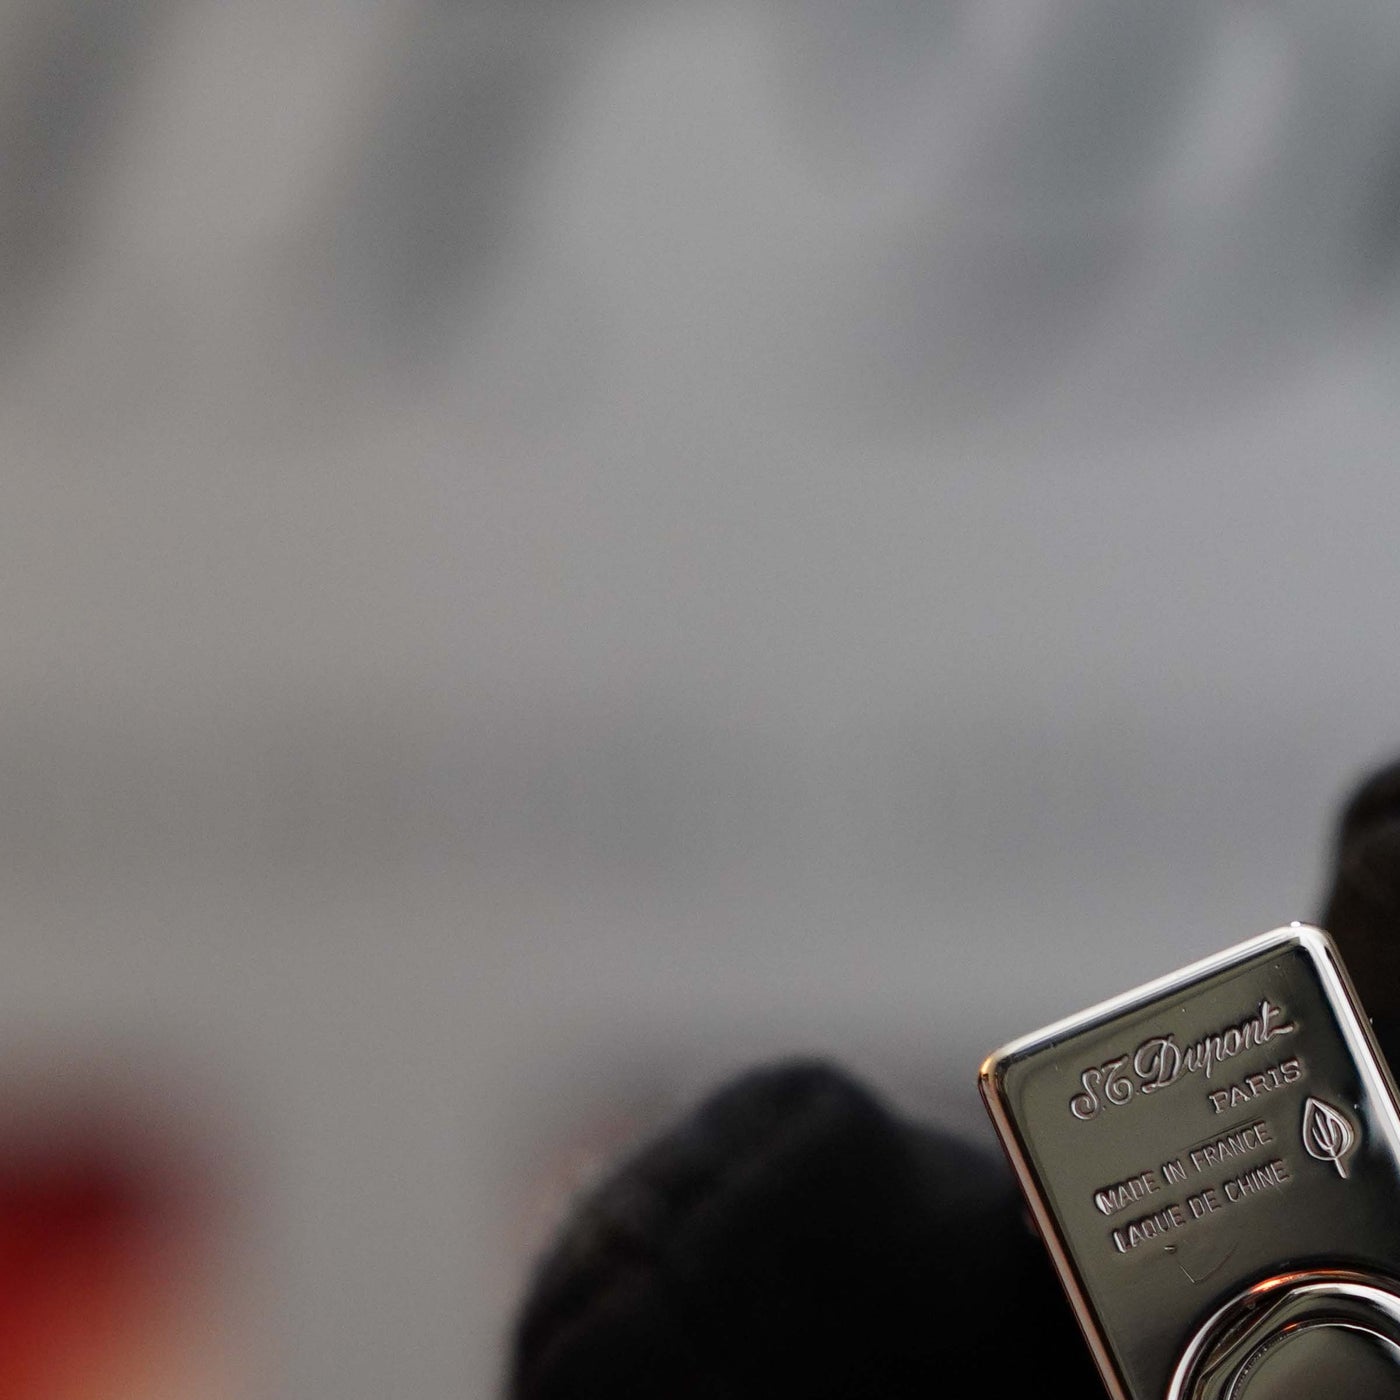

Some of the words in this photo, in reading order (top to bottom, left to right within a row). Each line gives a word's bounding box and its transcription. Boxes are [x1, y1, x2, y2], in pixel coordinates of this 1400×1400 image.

[1133, 999, 1296, 1095] Dupont
[1208, 1057, 1302, 1115] PARIS
[1094, 1170, 1161, 1216] MADE
[1161, 1159, 1187, 1186] IN
[1189, 1120, 1273, 1173] FRANCE
[1112, 1204, 1186, 1254] LAQUE
[1187, 1188, 1222, 1219] DE
[1223, 1158, 1290, 1204] CHINE
